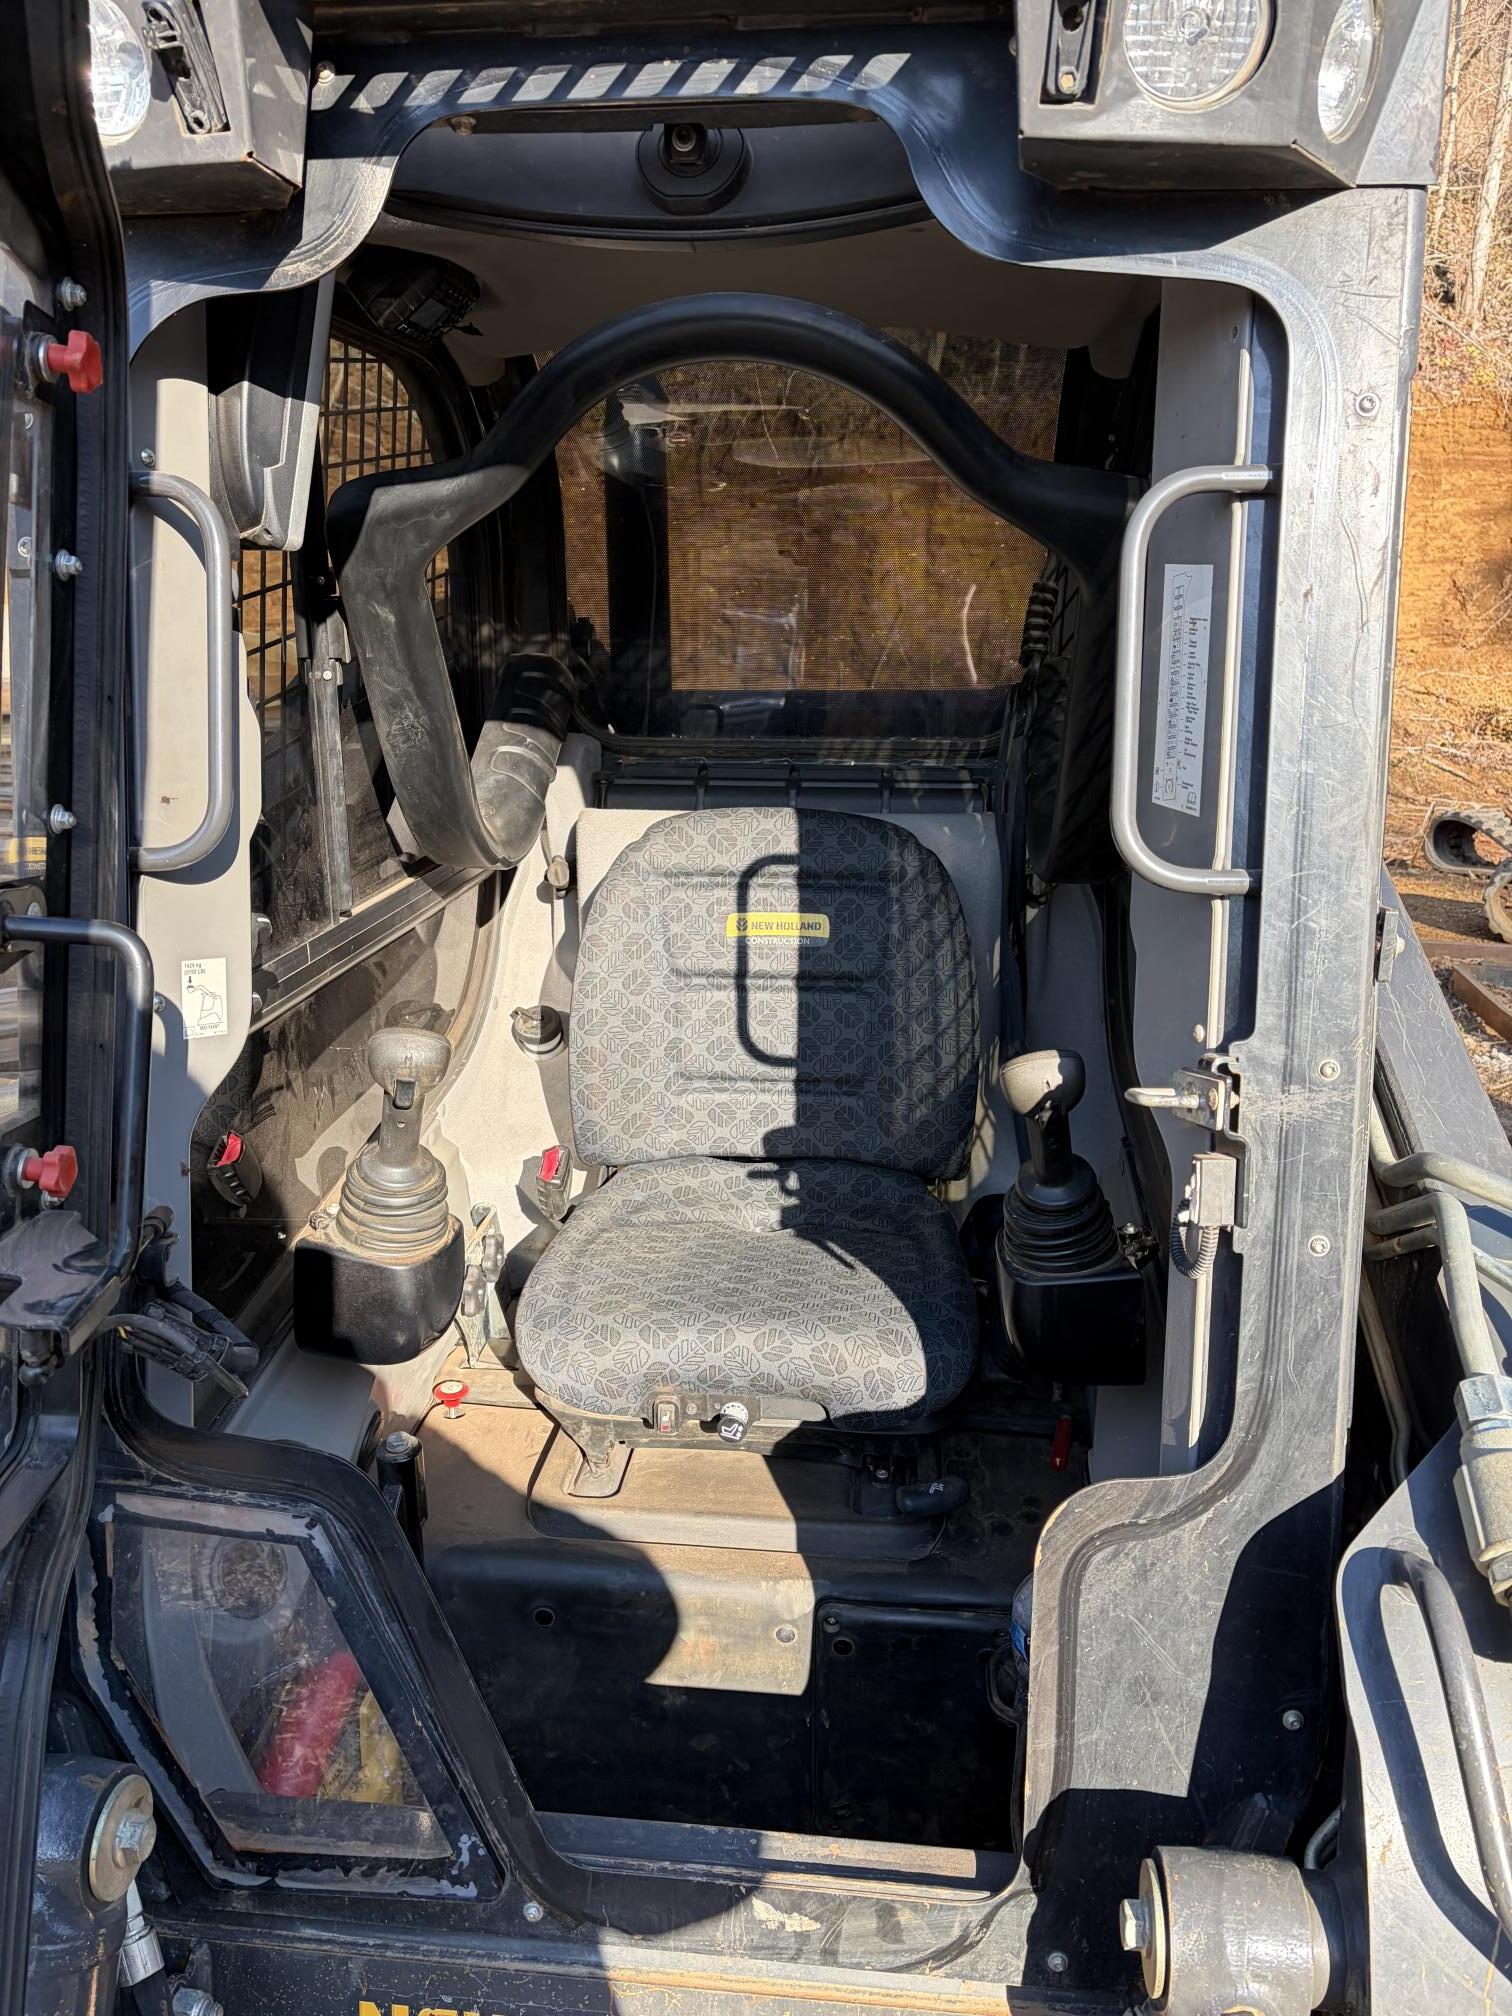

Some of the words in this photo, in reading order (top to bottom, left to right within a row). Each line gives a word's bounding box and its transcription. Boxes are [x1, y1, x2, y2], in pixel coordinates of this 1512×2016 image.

[751, 921, 774, 930] NEW
[776, 921, 822, 931] HOLLAND
[745, 937, 810, 945] CONSTRUCTION
